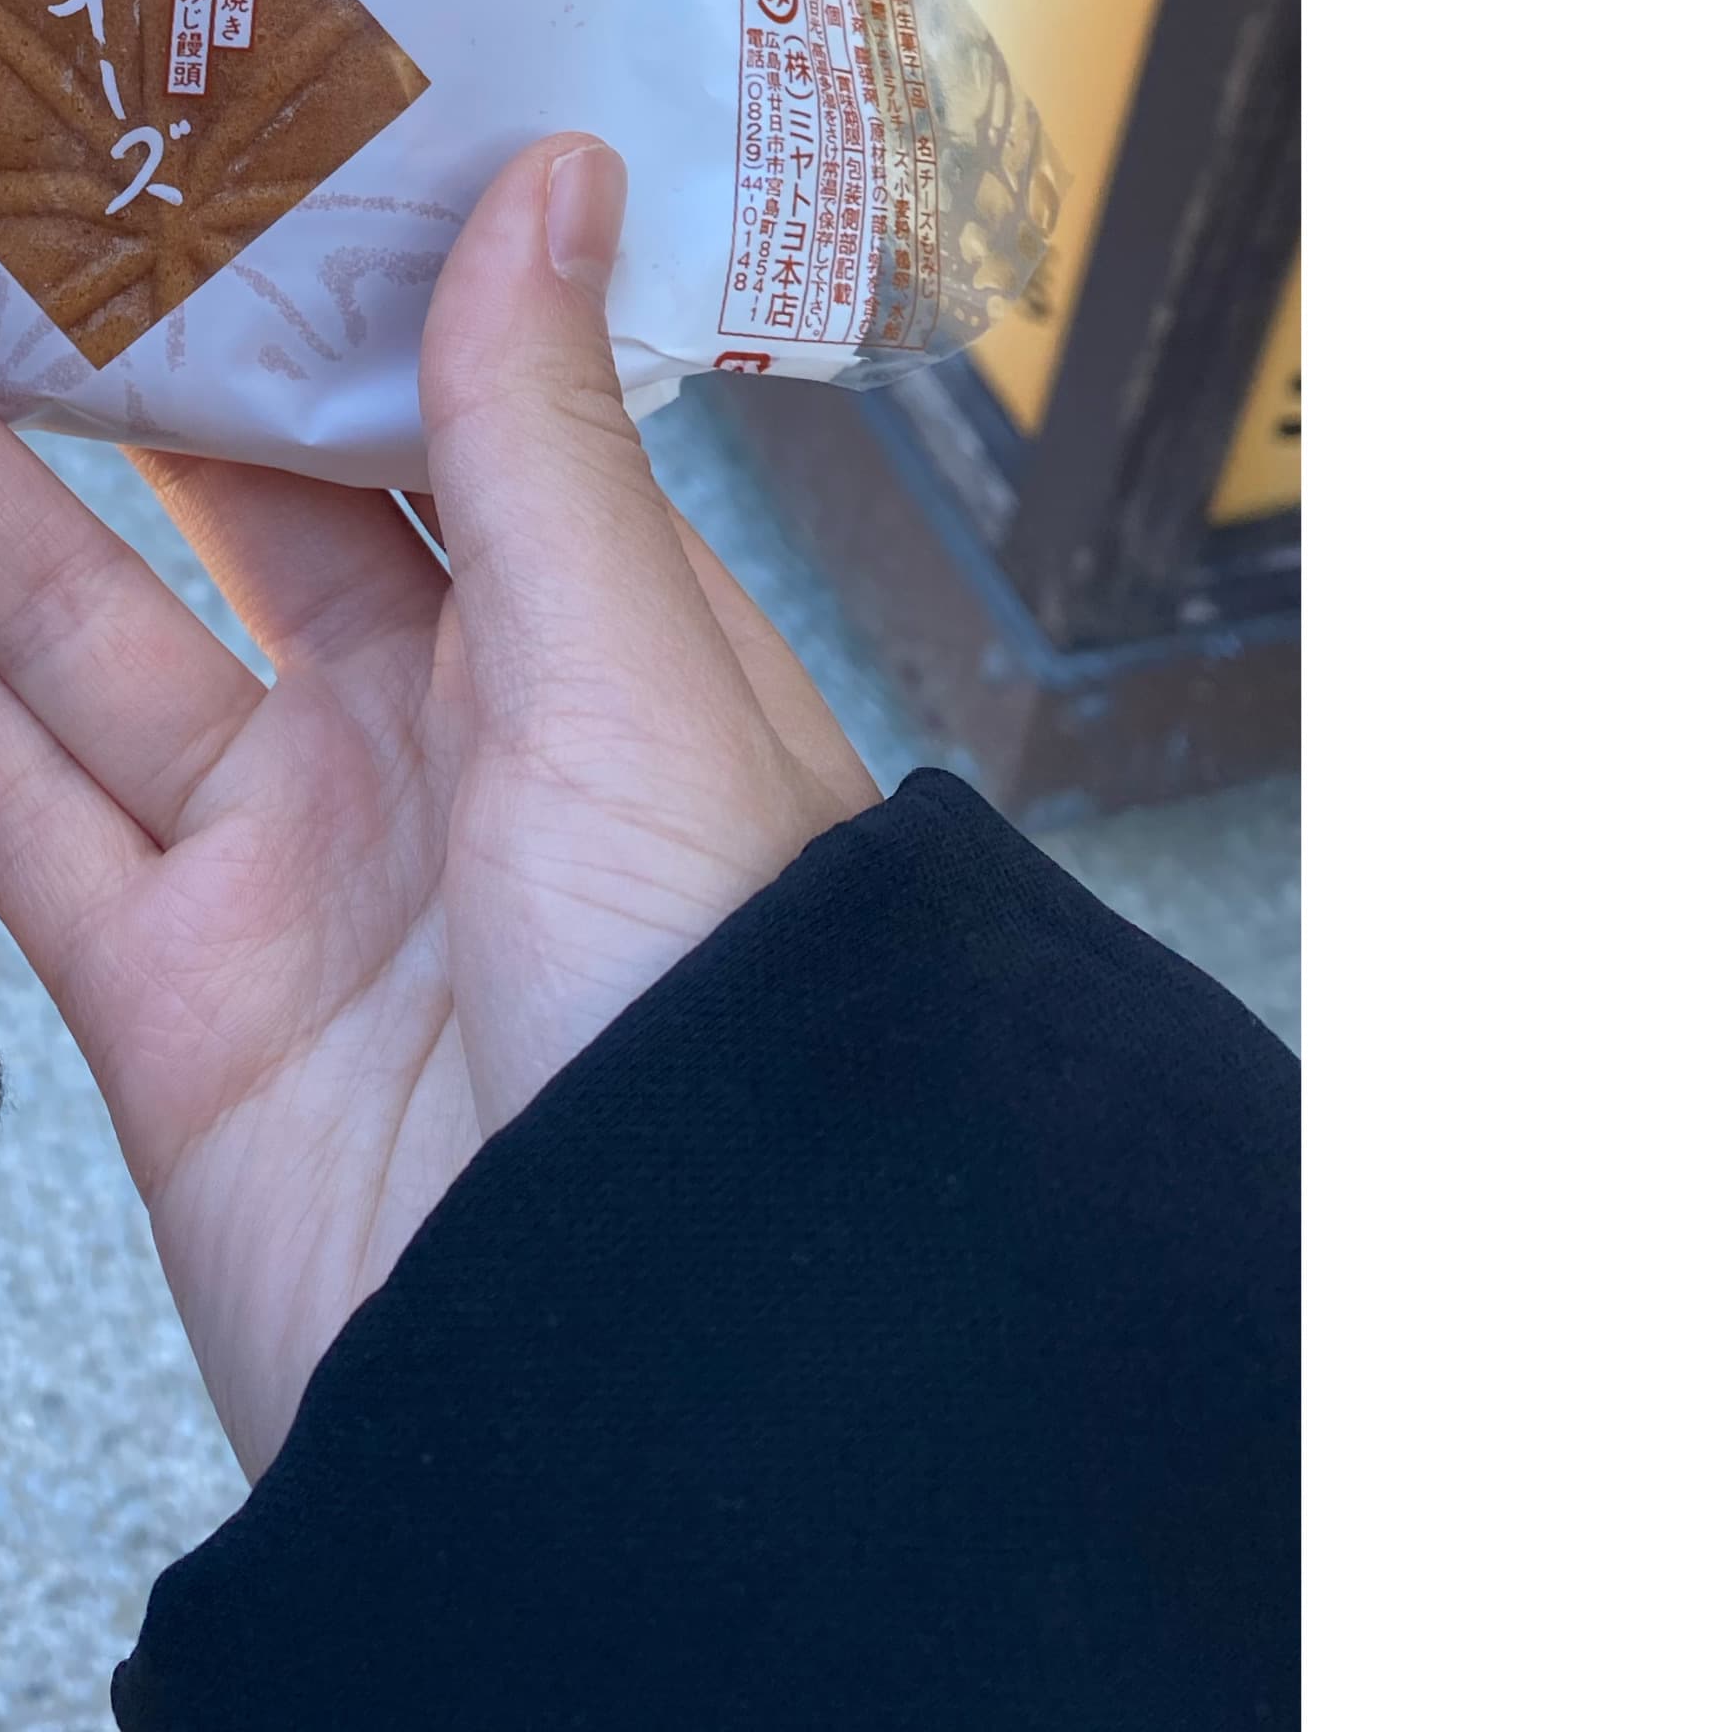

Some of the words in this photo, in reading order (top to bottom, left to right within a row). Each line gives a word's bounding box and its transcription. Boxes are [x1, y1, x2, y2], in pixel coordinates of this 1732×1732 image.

[765, 34, 814, 328] (株)ミヤトヨ本店
[835, 73, 862, 148] 賞味期限
[832, 157, 863, 307] 包装側部記載
